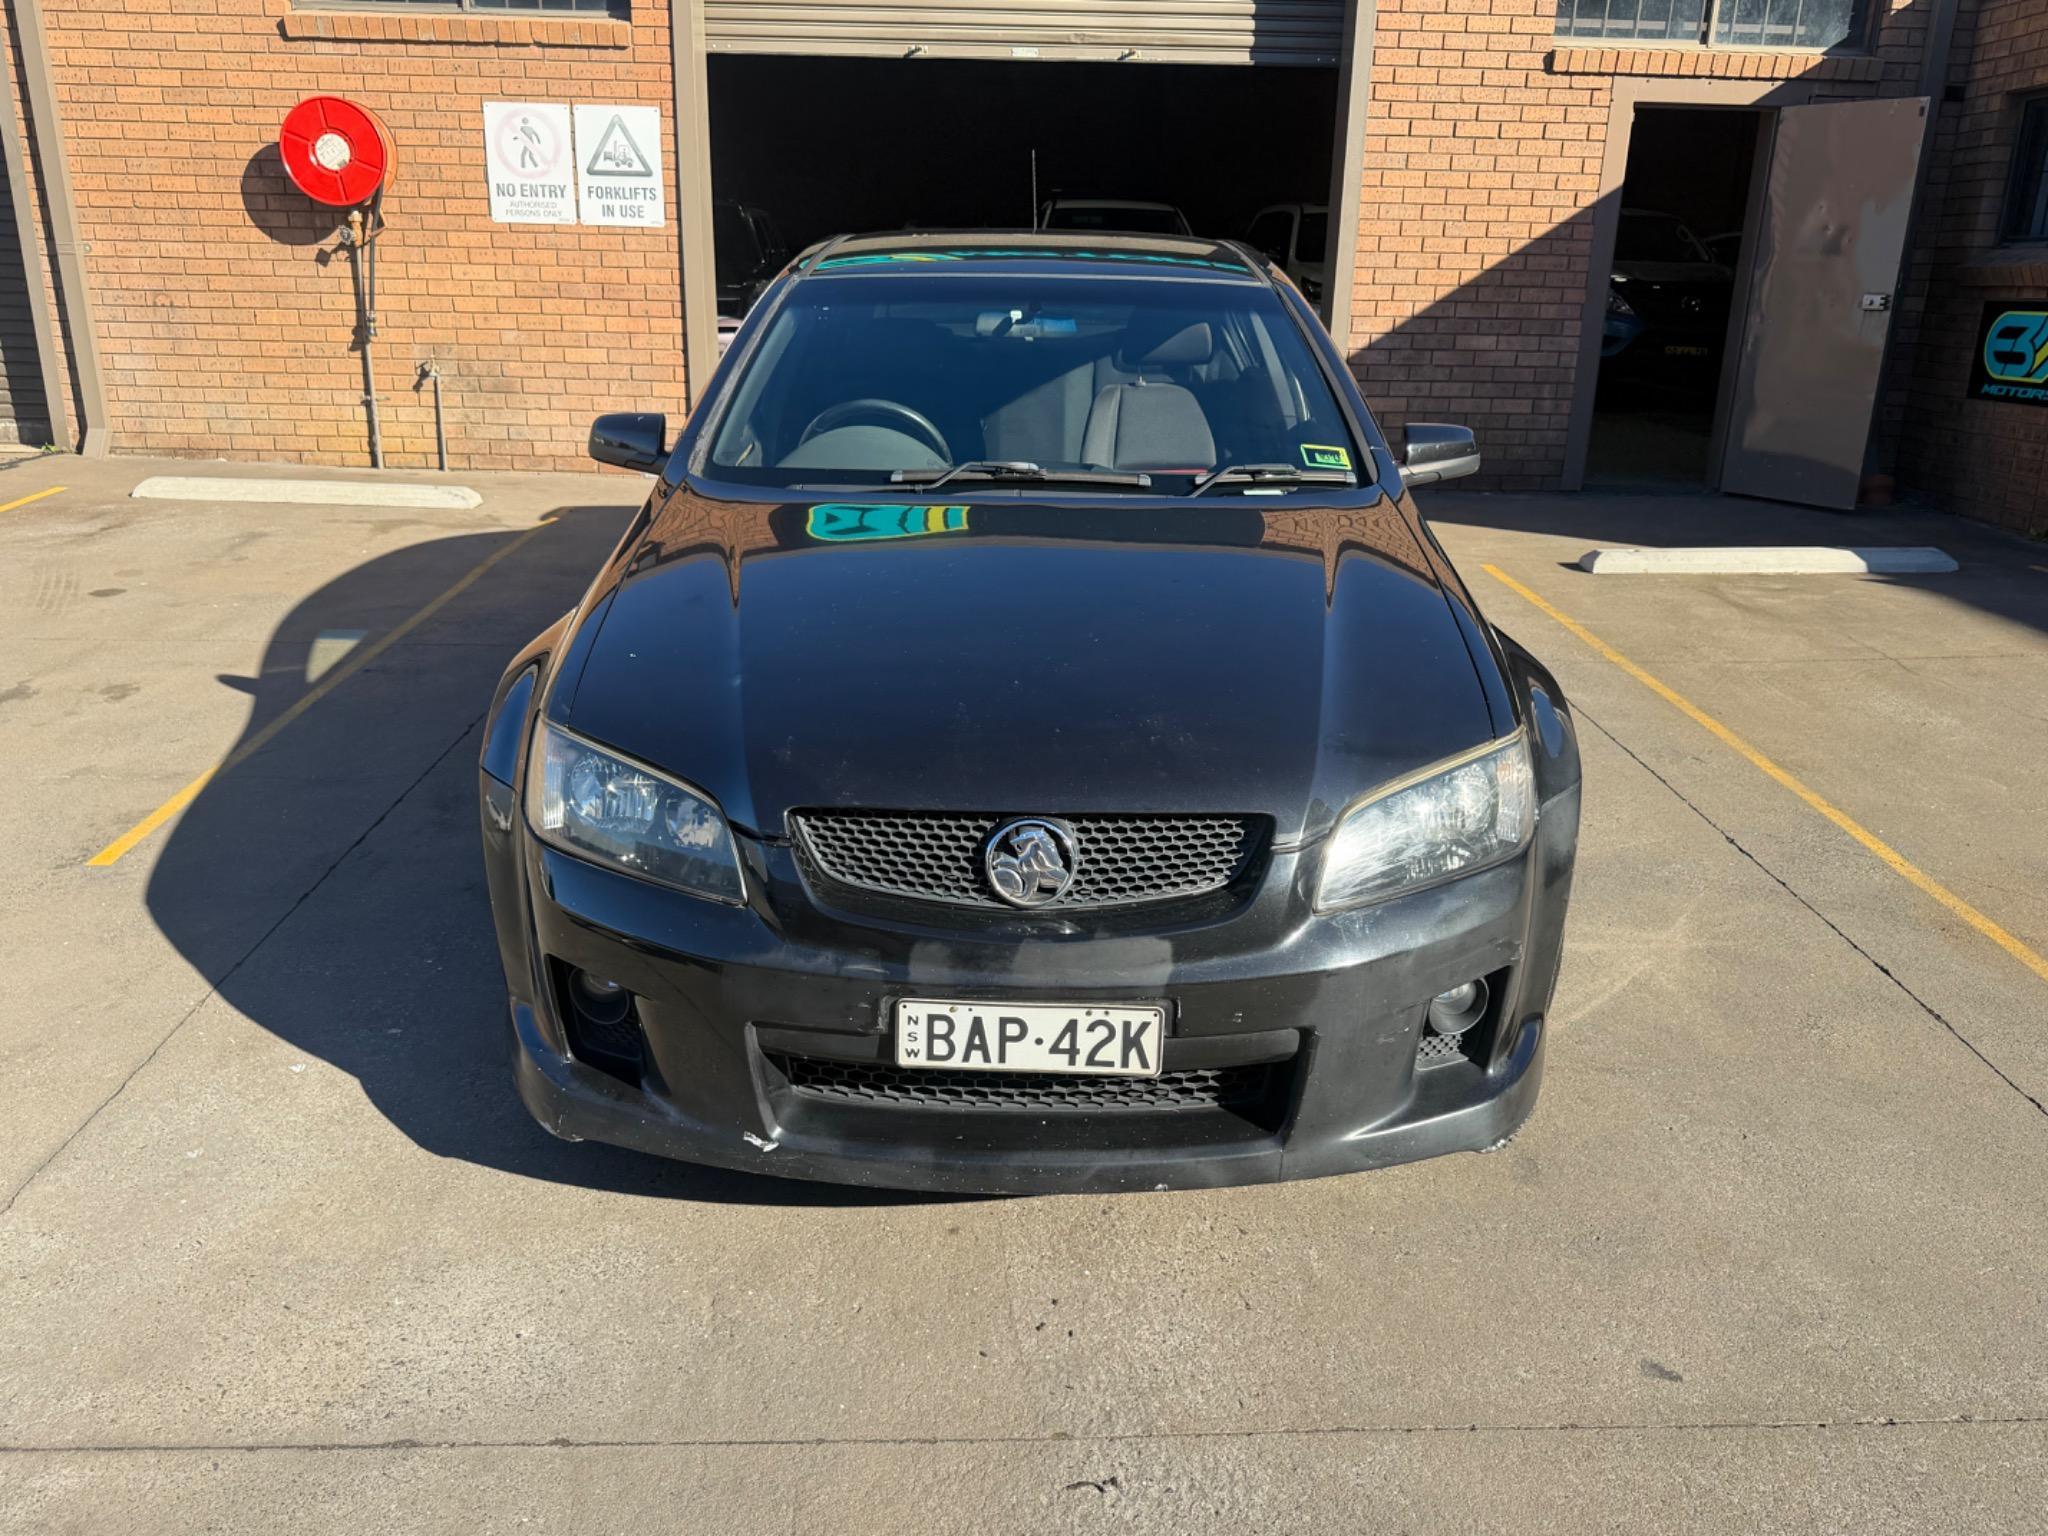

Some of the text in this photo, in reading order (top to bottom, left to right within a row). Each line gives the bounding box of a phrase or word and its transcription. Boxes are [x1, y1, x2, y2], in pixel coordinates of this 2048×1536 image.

[495, 183, 567, 199] NO ENTRY
[587, 185, 657, 201] FORKLIFTS
[509, 200, 558, 209] AUTHORISED
[601, 204, 645, 219] IN USE
[505, 208, 563, 218] PERSONS ONLY
[905, 1015, 920, 1058] NSW
